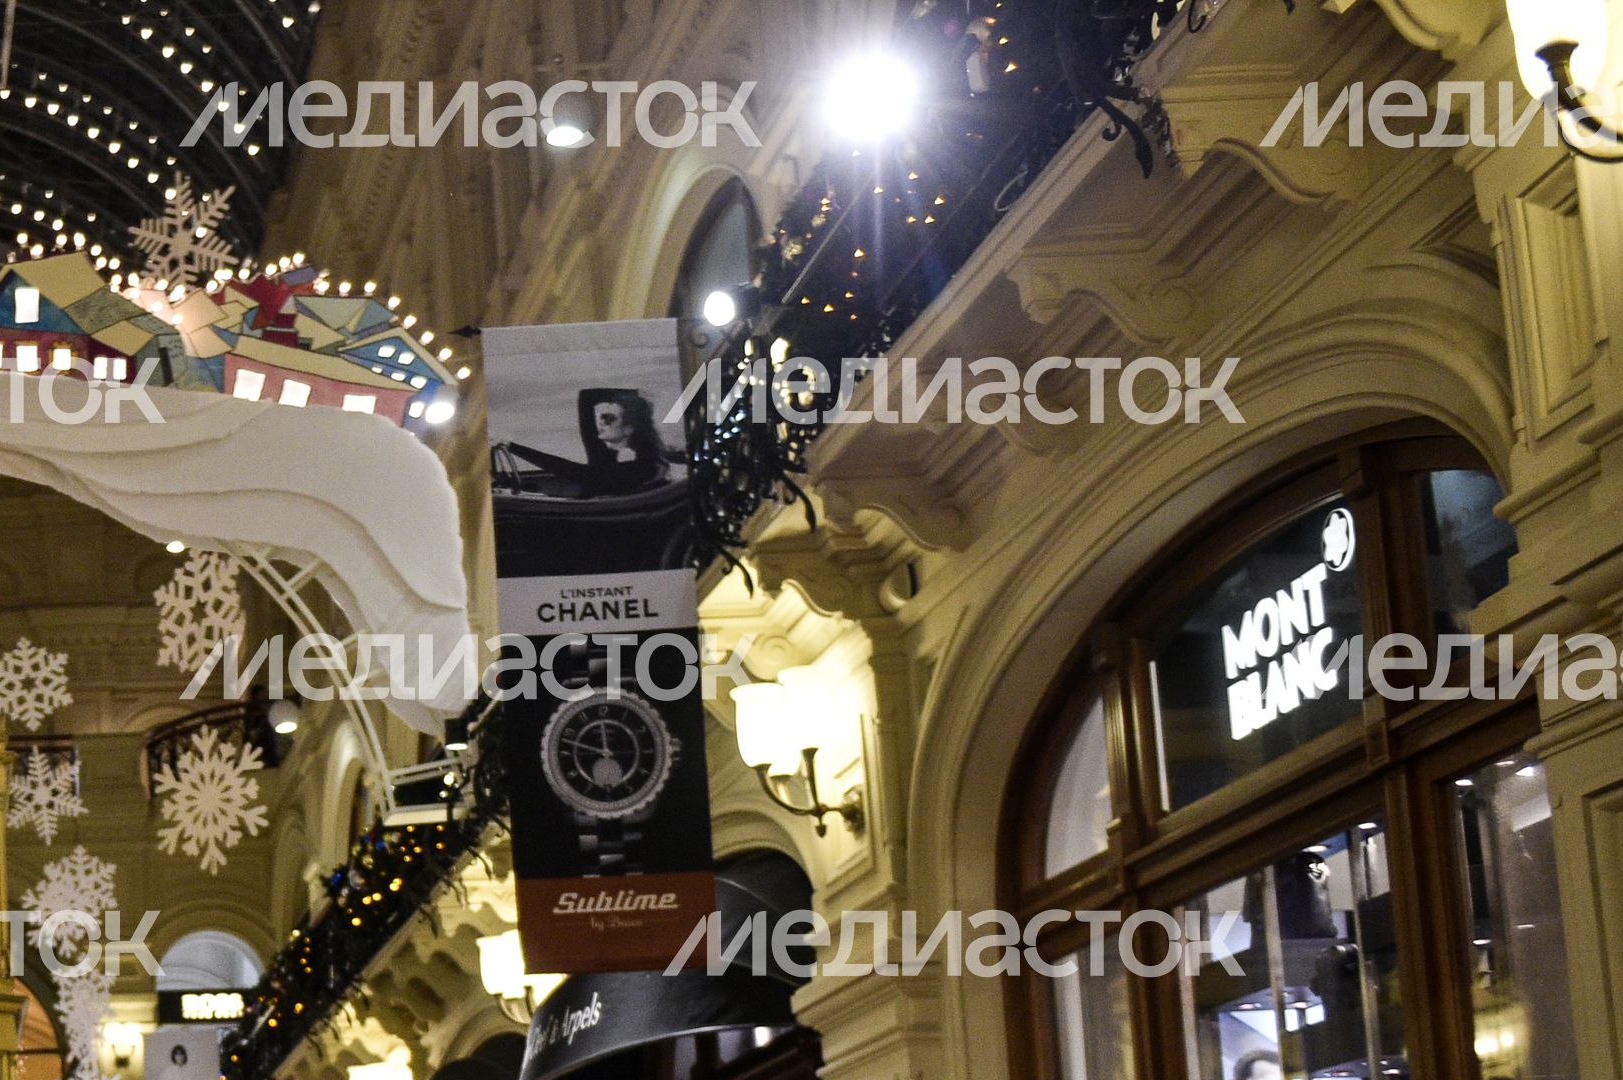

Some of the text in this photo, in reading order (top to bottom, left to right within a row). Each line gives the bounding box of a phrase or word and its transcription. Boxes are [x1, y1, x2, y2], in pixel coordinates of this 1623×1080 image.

[537, 599, 659, 623] CHANEL
[560, 586, 633, 599] L'INSTANT
[1221, 562, 1328, 680] MONT
[1226, 626, 1339, 741] BLANC
[552, 889, 680, 915] Sublime
[562, 991, 602, 1046] Arpels
